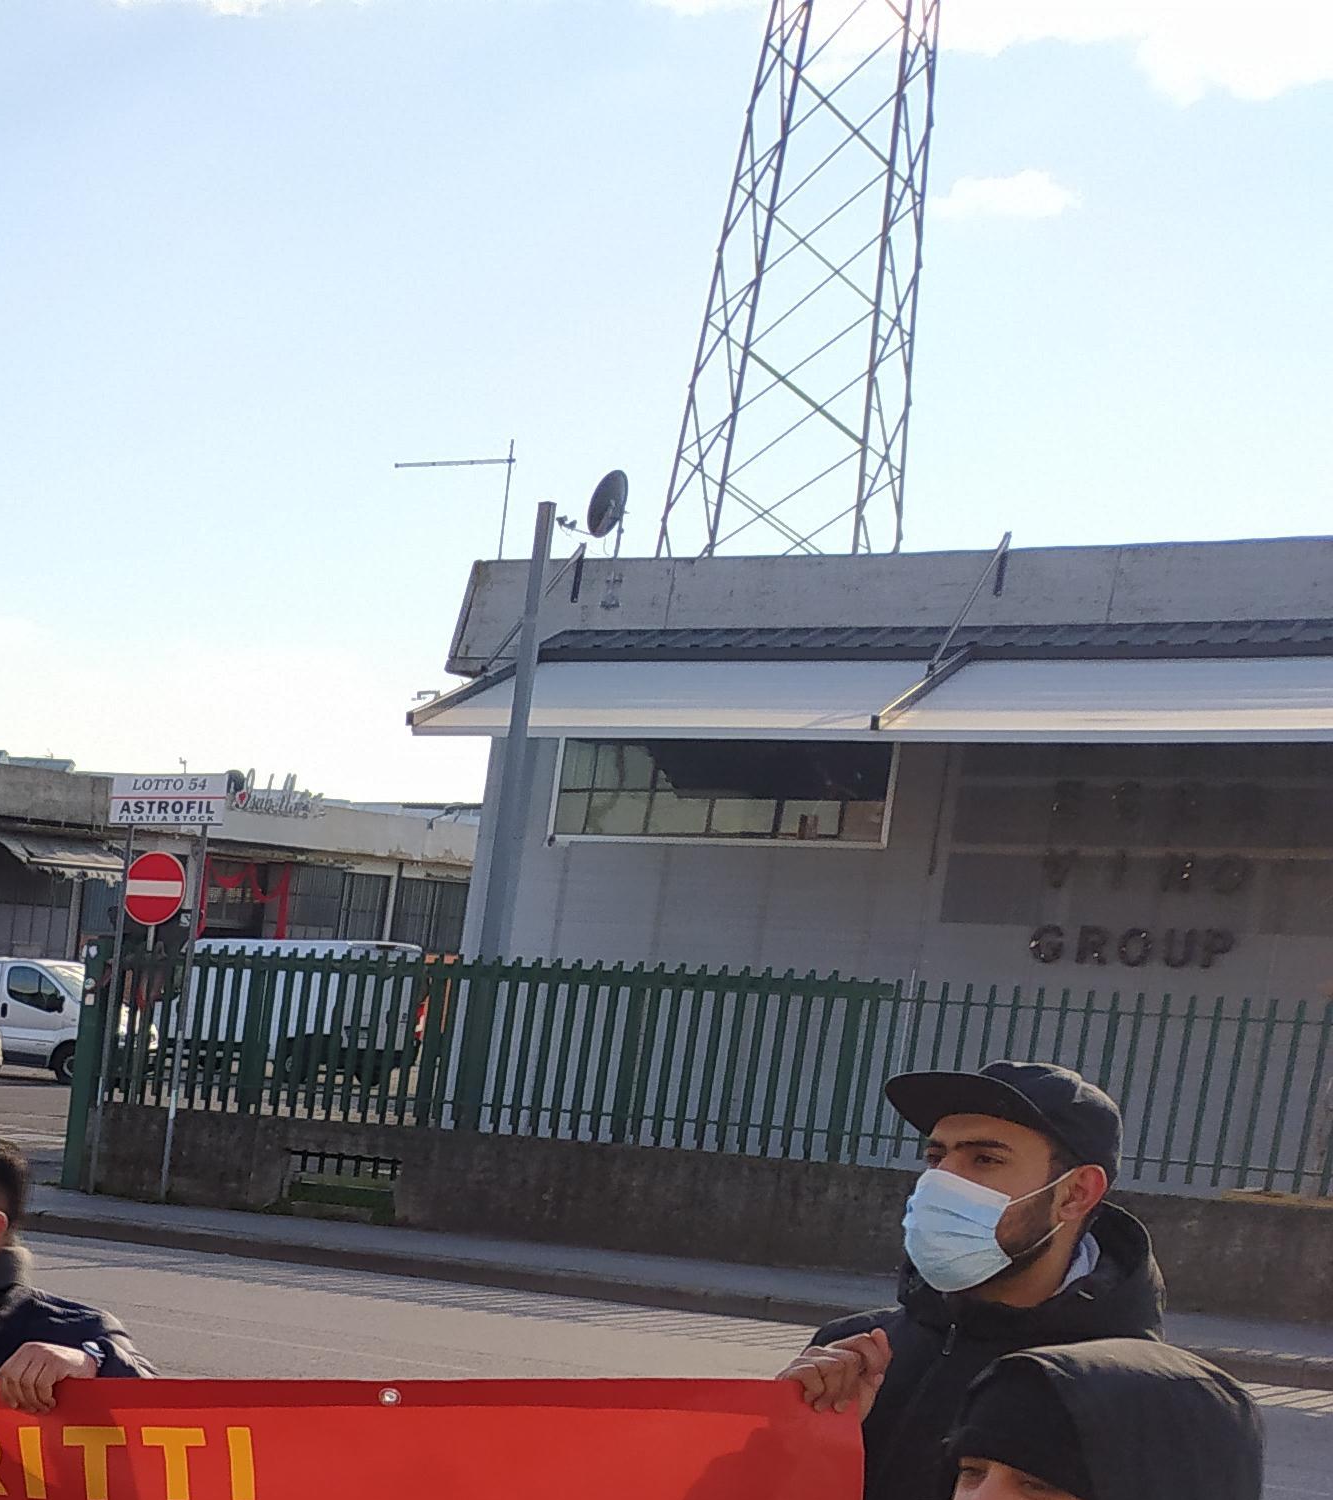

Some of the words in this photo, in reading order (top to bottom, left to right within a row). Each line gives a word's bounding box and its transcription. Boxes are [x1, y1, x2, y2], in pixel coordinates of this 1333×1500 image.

[132, 778, 183, 792] LOTTO
[188, 777, 208, 792] 54
[119, 800, 216, 817] ASTROFIL
[118, 814, 156, 823] FILATI
[160, 815, 170, 823] A
[174, 815, 215, 823] STOCK
[1028, 923, 1236, 970] GROUP
